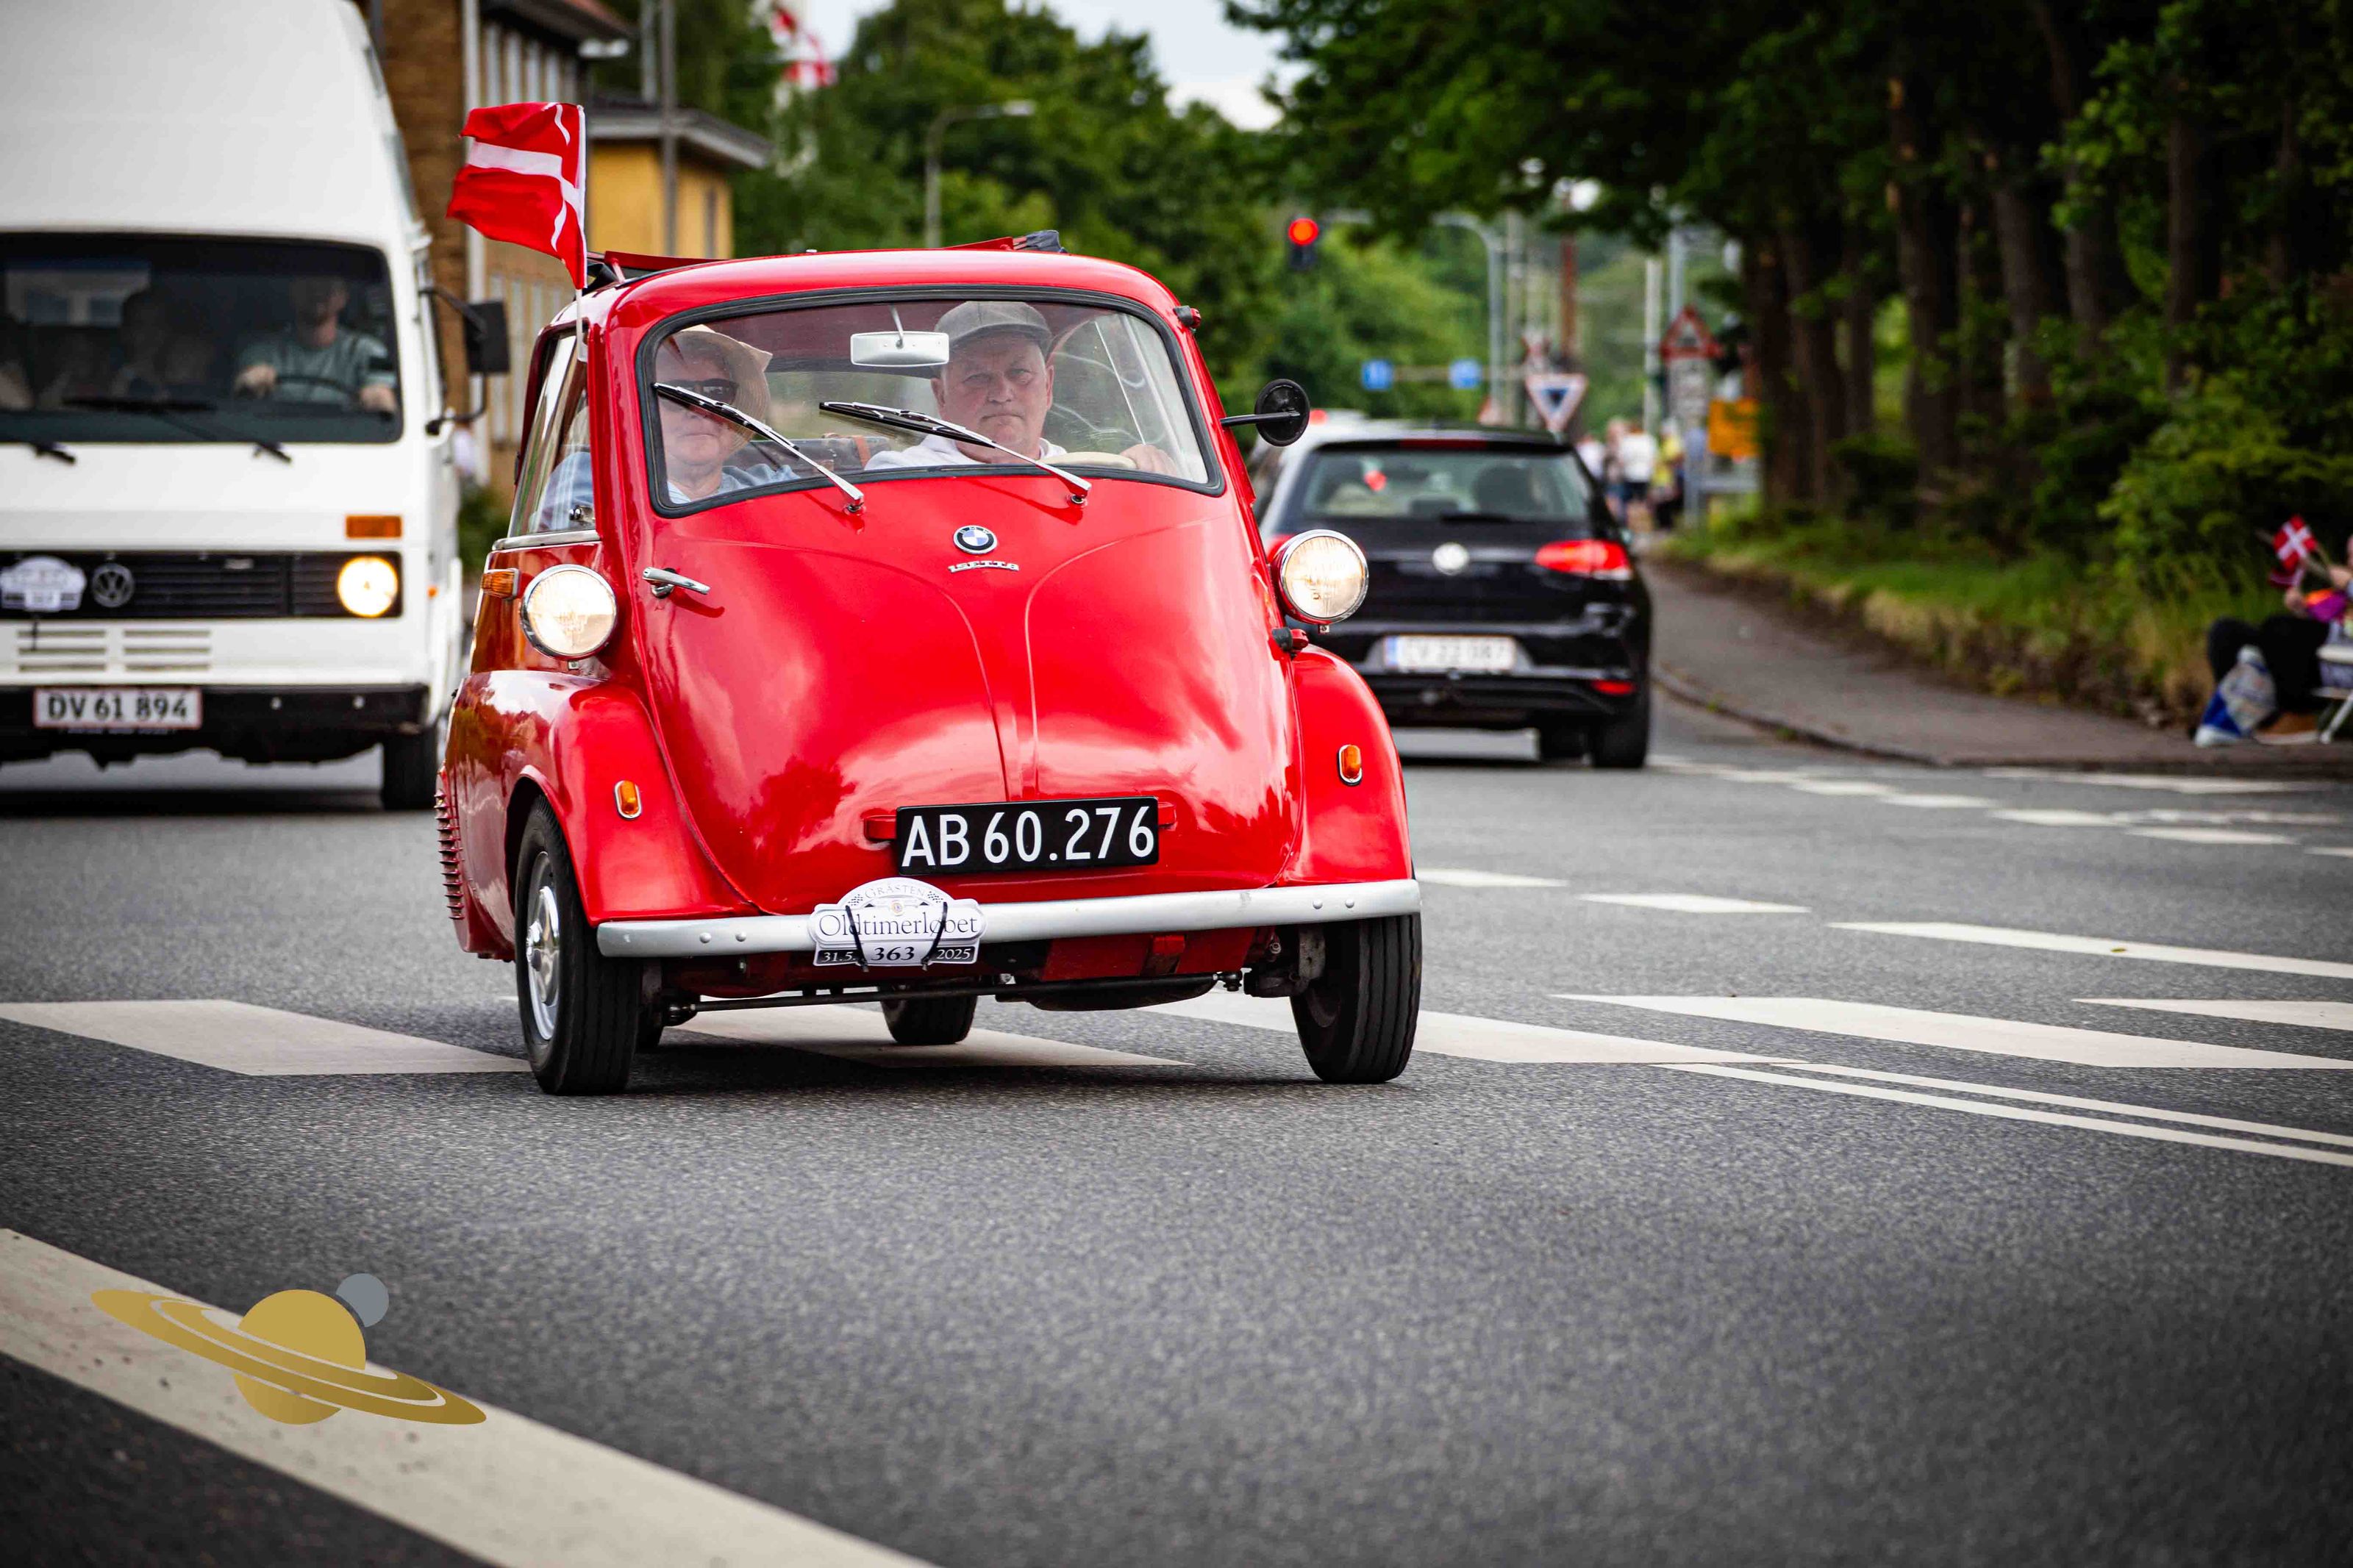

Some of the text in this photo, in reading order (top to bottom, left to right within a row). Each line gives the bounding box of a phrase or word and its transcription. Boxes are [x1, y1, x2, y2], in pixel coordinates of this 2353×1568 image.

[48, 694, 188, 720] DV 61 894
[902, 806, 1154, 867] AB 60.276
[821, 946, 971, 962] 31.5. 363 2025
